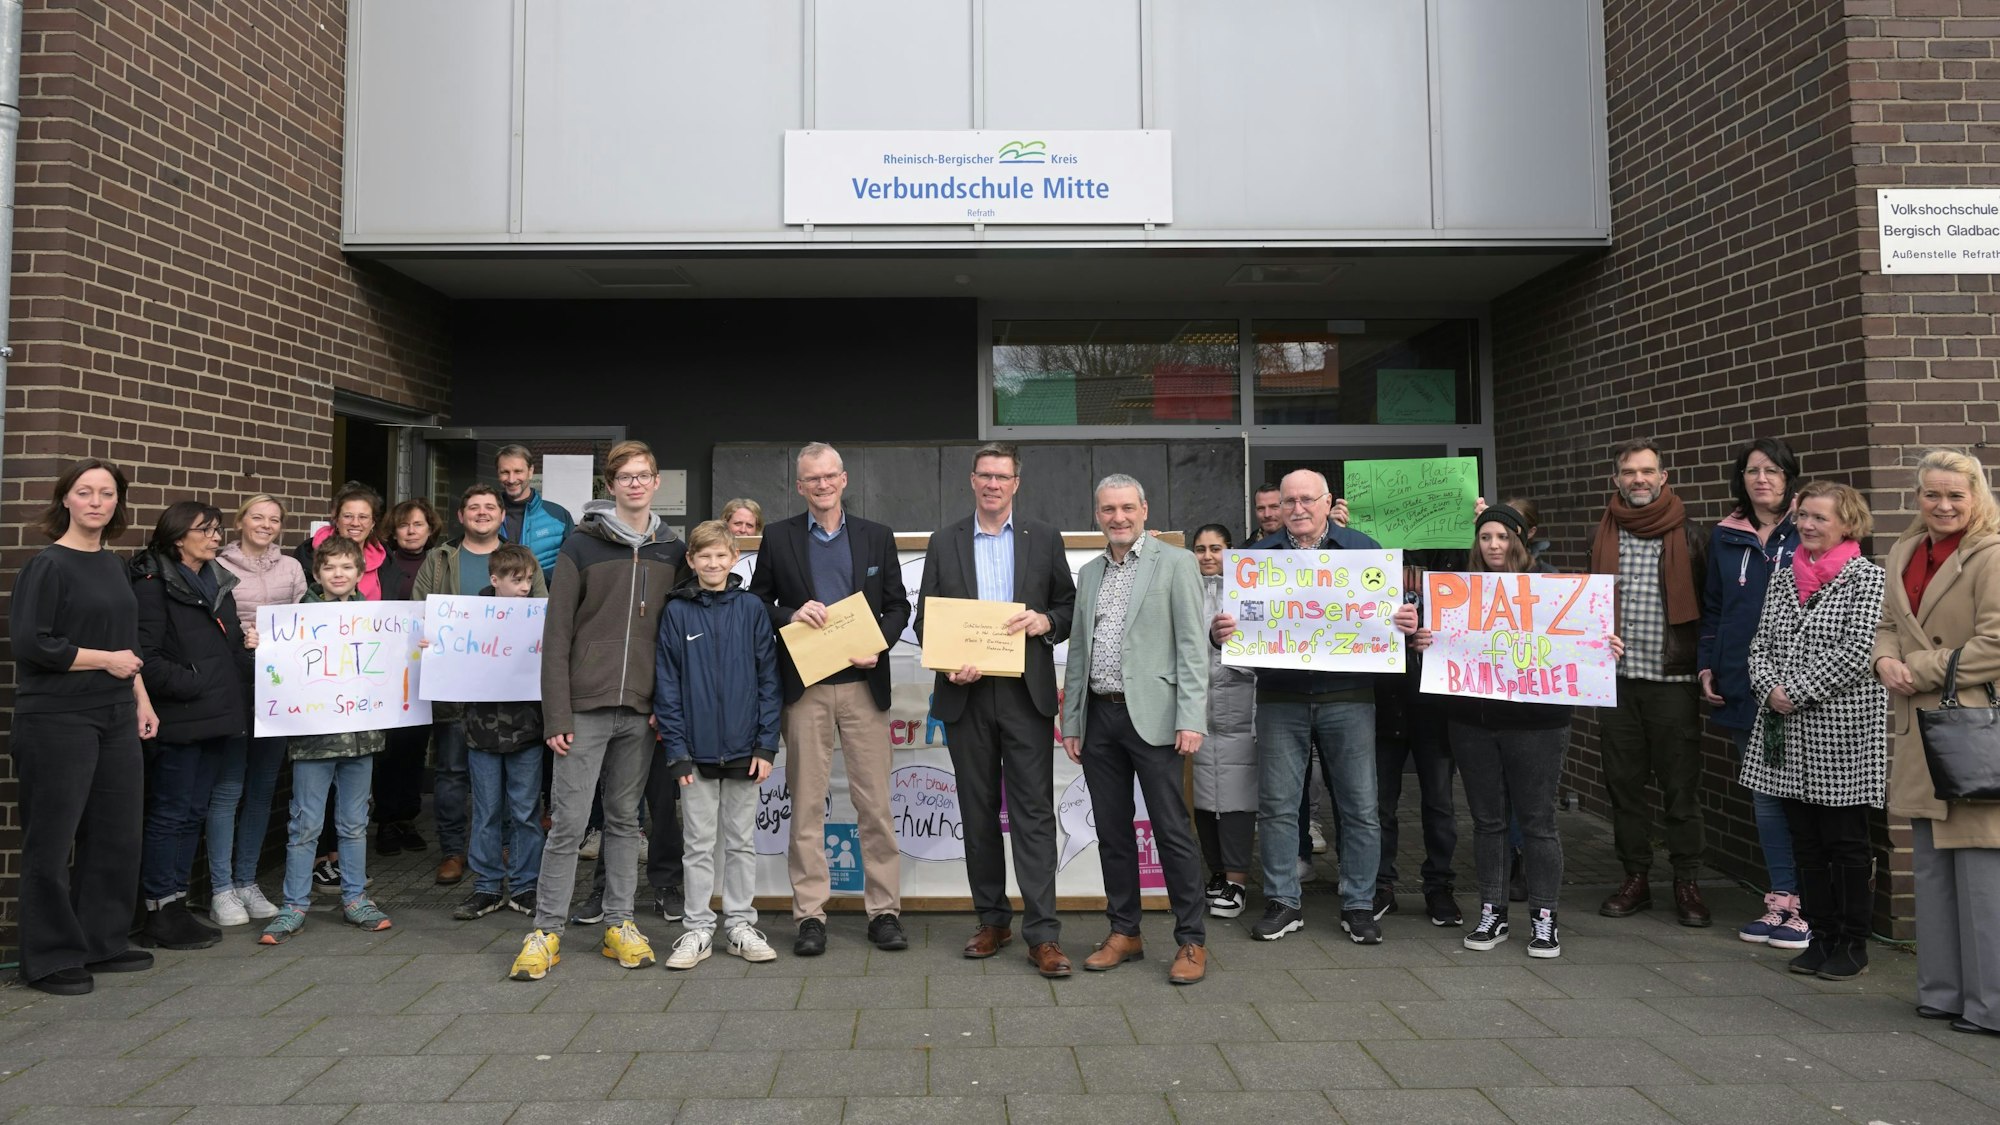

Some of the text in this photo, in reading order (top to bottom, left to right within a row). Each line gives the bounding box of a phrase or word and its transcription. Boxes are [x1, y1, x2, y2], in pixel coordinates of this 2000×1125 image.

[883, 154, 1078, 166] Rheinisch-Bergischer Kreis
[852, 176, 1109, 199] Verbundschule Mitte
[967, 208, 995, 217] Refrath
[1891, 204, 1998, 215] Volkshochschule
[1884, 225, 2000, 238] Bergisch Gladbac
[1892, 250, 1957, 259] Außenstelle
[1375, 467, 1408, 490] Kein
[1236, 557, 1349, 589] Gib uns
[438, 602, 469, 619] Ohne
[485, 604, 512, 620] Hof
[1269, 599, 1392, 623] unseren
[271, 612, 420, 642] Wir brauchen
[303, 642, 385, 676] PLATZ
[334, 694, 384, 716] Spielen
[896, 772, 923, 789] Wir
